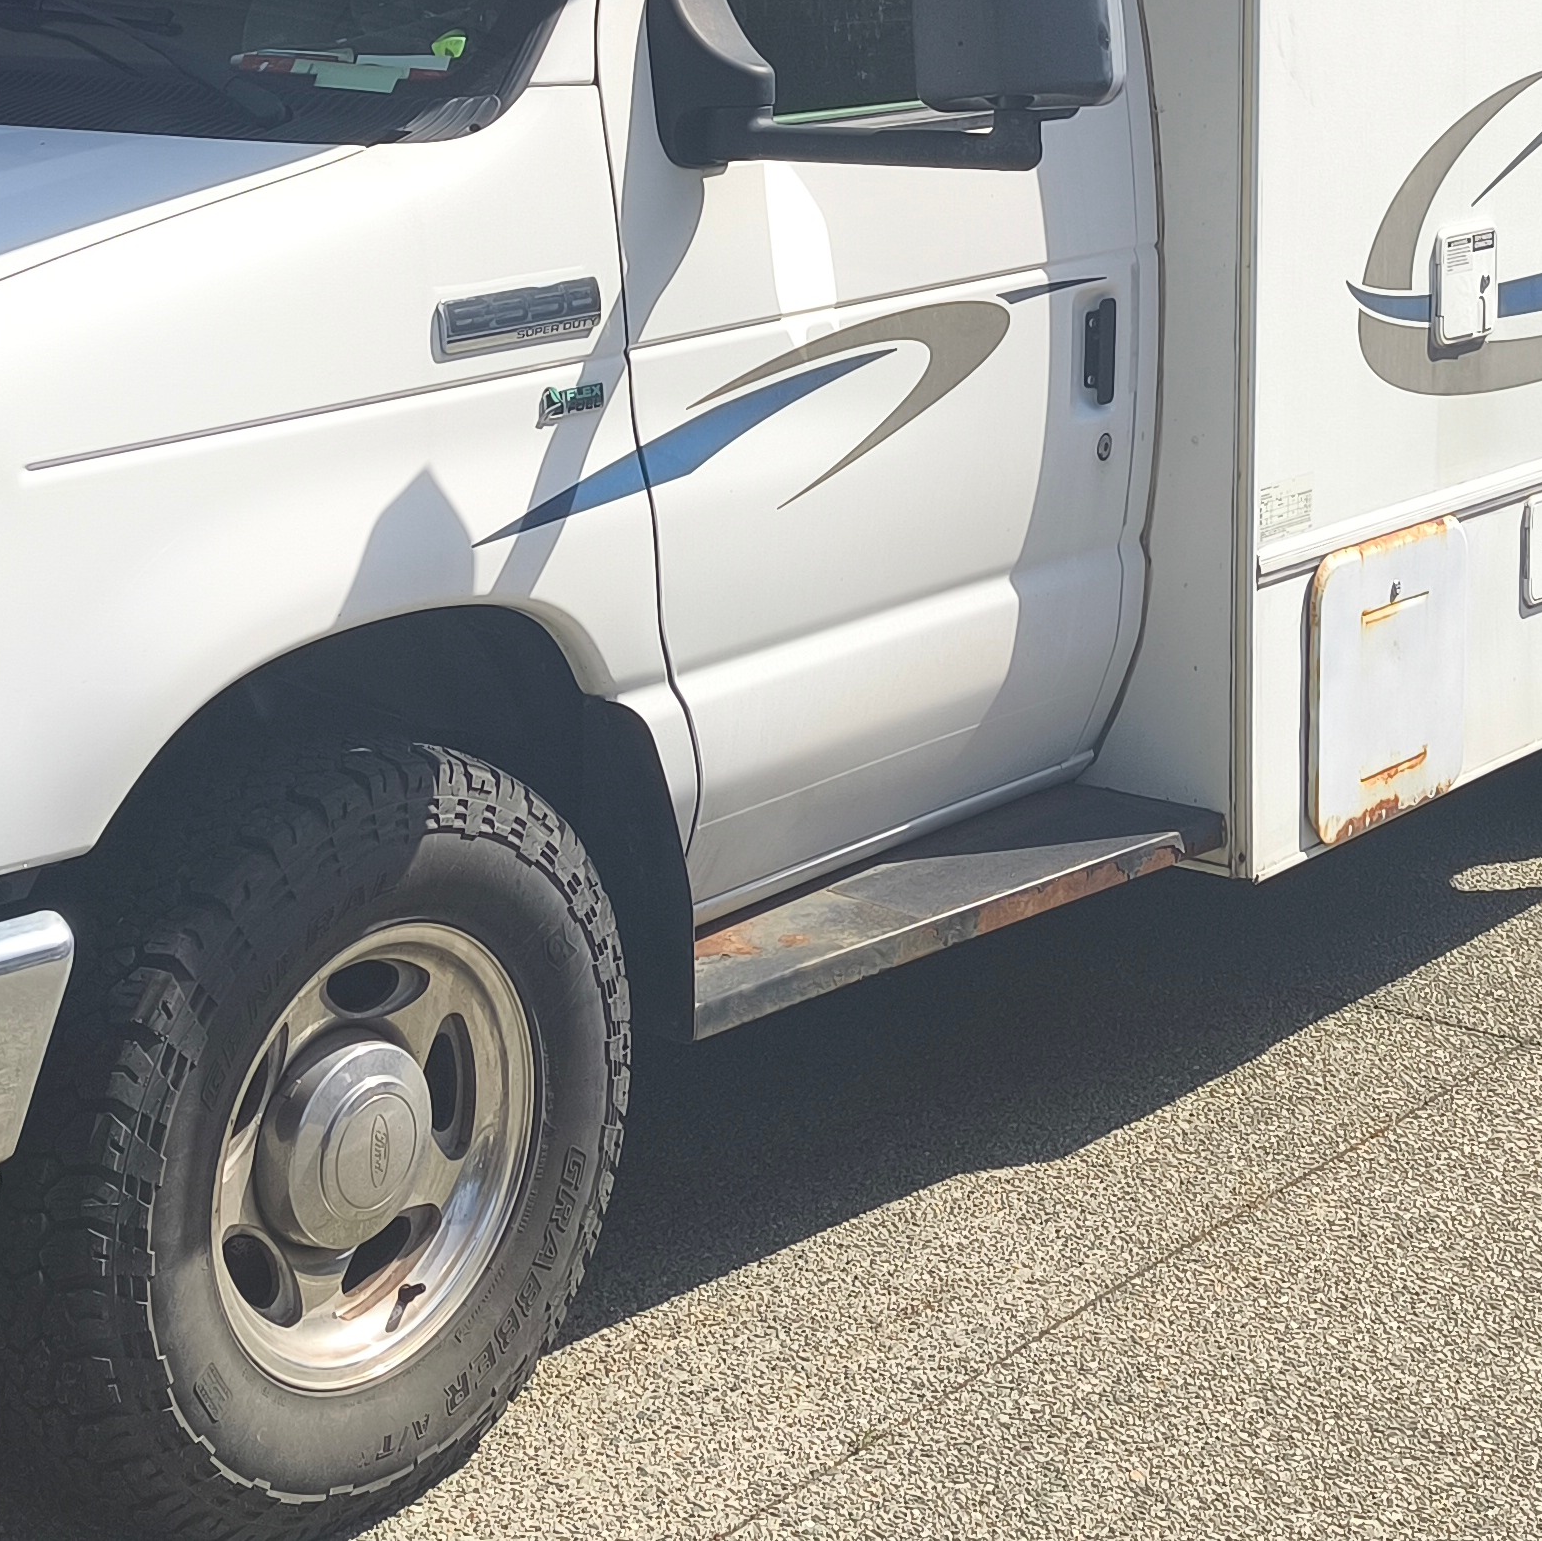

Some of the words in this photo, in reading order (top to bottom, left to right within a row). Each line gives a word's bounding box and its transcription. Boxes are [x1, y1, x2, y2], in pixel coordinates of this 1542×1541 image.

[516, 324, 559, 339] SUPER
[562, 317, 598, 331] DUTY
[565, 384, 602, 402] FLEX
[443, 1143, 587, 1417] GRABBER
